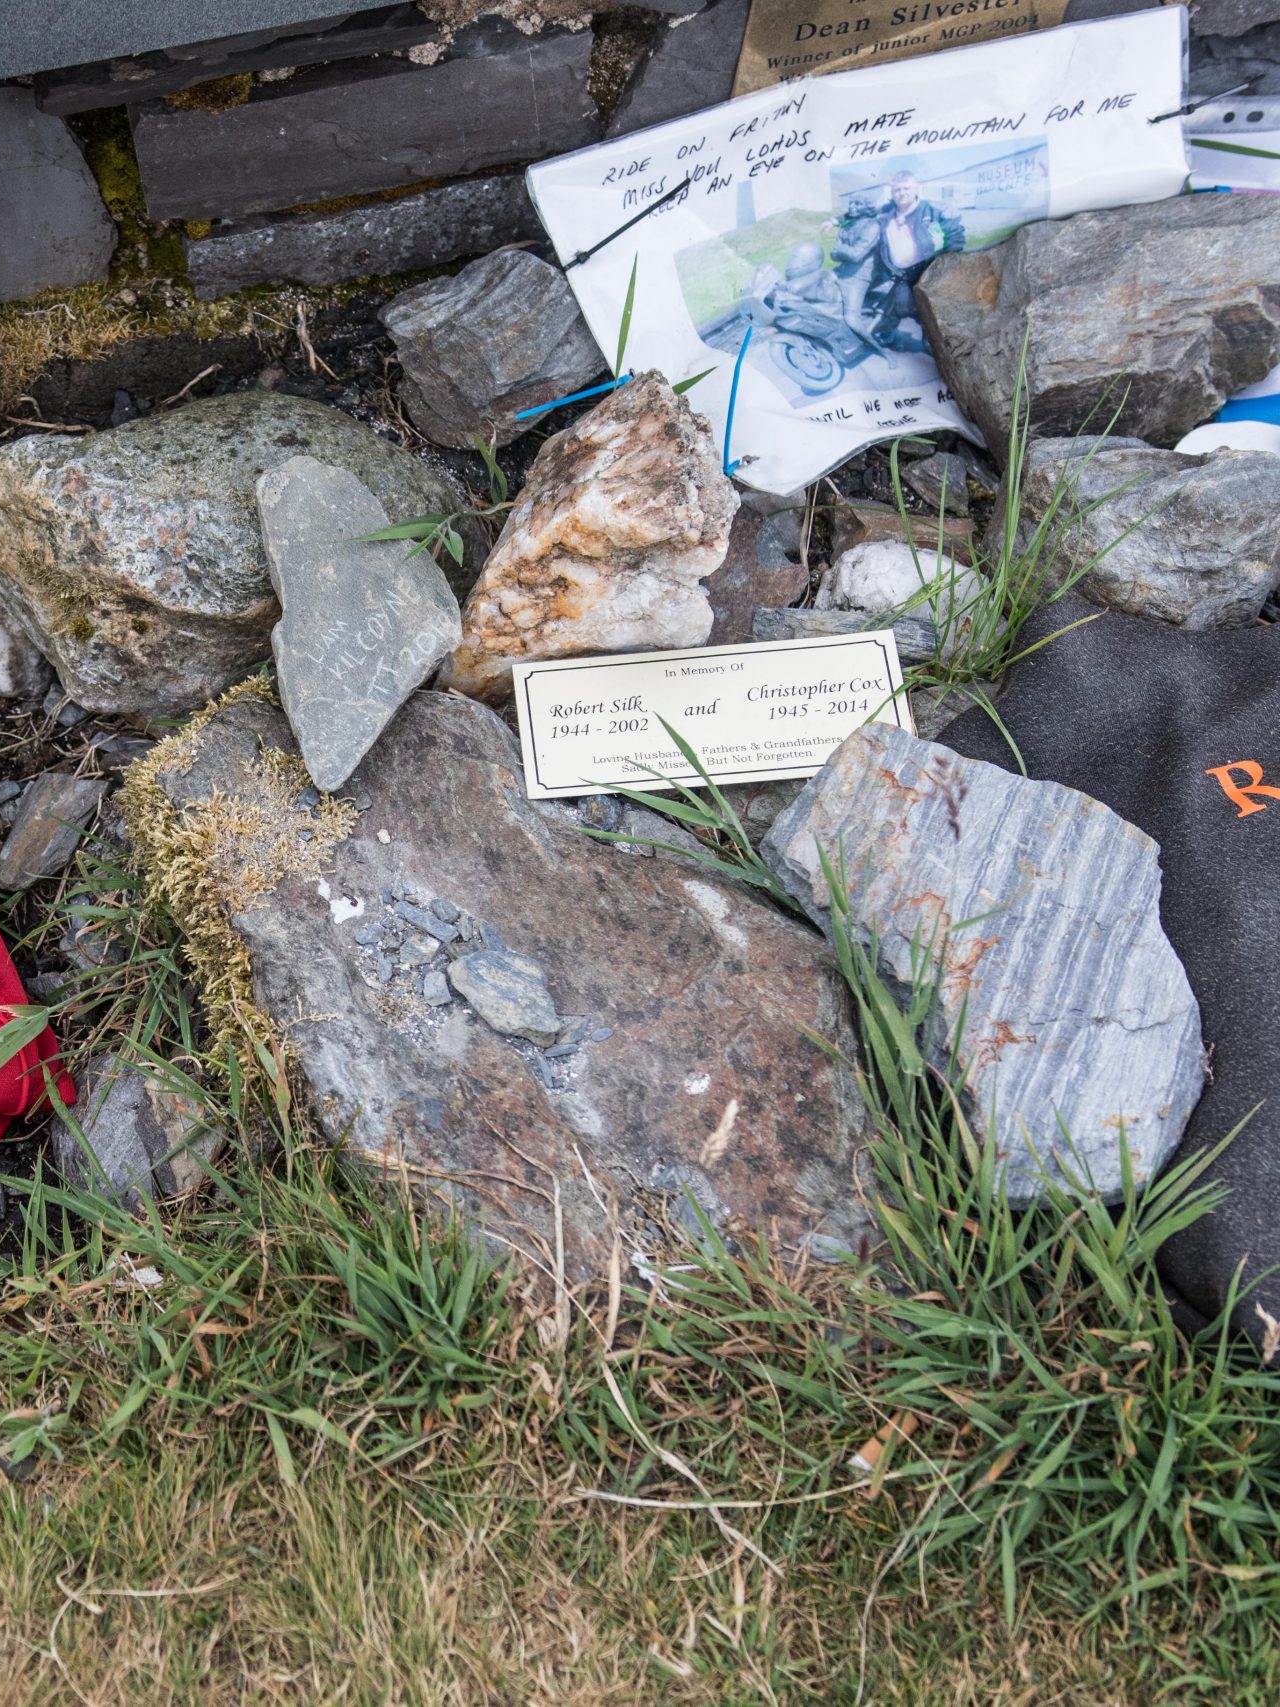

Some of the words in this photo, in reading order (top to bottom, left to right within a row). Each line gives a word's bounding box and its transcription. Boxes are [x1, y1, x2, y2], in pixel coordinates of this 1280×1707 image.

[793, 15, 870, 42] Dean
[767, 48, 834, 70] Winner
[842, 43, 862, 57] of
[870, 33, 931, 54] junior
[939, 23, 981, 42] MGP
[706, 173, 733, 195] AN
[748, 155, 786, 178] EYE
[804, 146, 835, 163] ON
[850, 140, 891, 159] THE
[907, 113, 1027, 146] MOUNTAIN
[1043, 99, 1084, 125] FOR
[1097, 93, 1137, 114] ME
[602, 157, 652, 186] RIDE
[677, 136, 706, 160] ON
[623, 175, 667, 210] MISS
[844, 108, 916, 137] MATE
[977, 158, 1036, 184] MUSEUM
[863, 399, 881, 413] WE
[664, 669, 676, 678] In
[681, 664, 727, 677] Memory
[730, 663, 745, 672] Of
[747, 679, 846, 702] Christopher
[849, 677, 886, 693] Cox
[549, 701, 606, 719] Robert
[609, 695, 649, 714] Silk
[684, 697, 721, 717] and
[768, 703, 809, 720] 1945
[827, 699, 869, 715] 2014
[551, 723, 590, 739] 1944
[608, 718, 649, 734] 2002
[593, 754, 630, 764] Loving
[702, 744, 747, 755] Fathers
[750, 740, 761, 751] &
[658, 759, 691, 769] Misse
[707, 756, 728, 765] But
[732, 754, 753, 763] Not
[757, 750, 817, 763] Forgotten.
